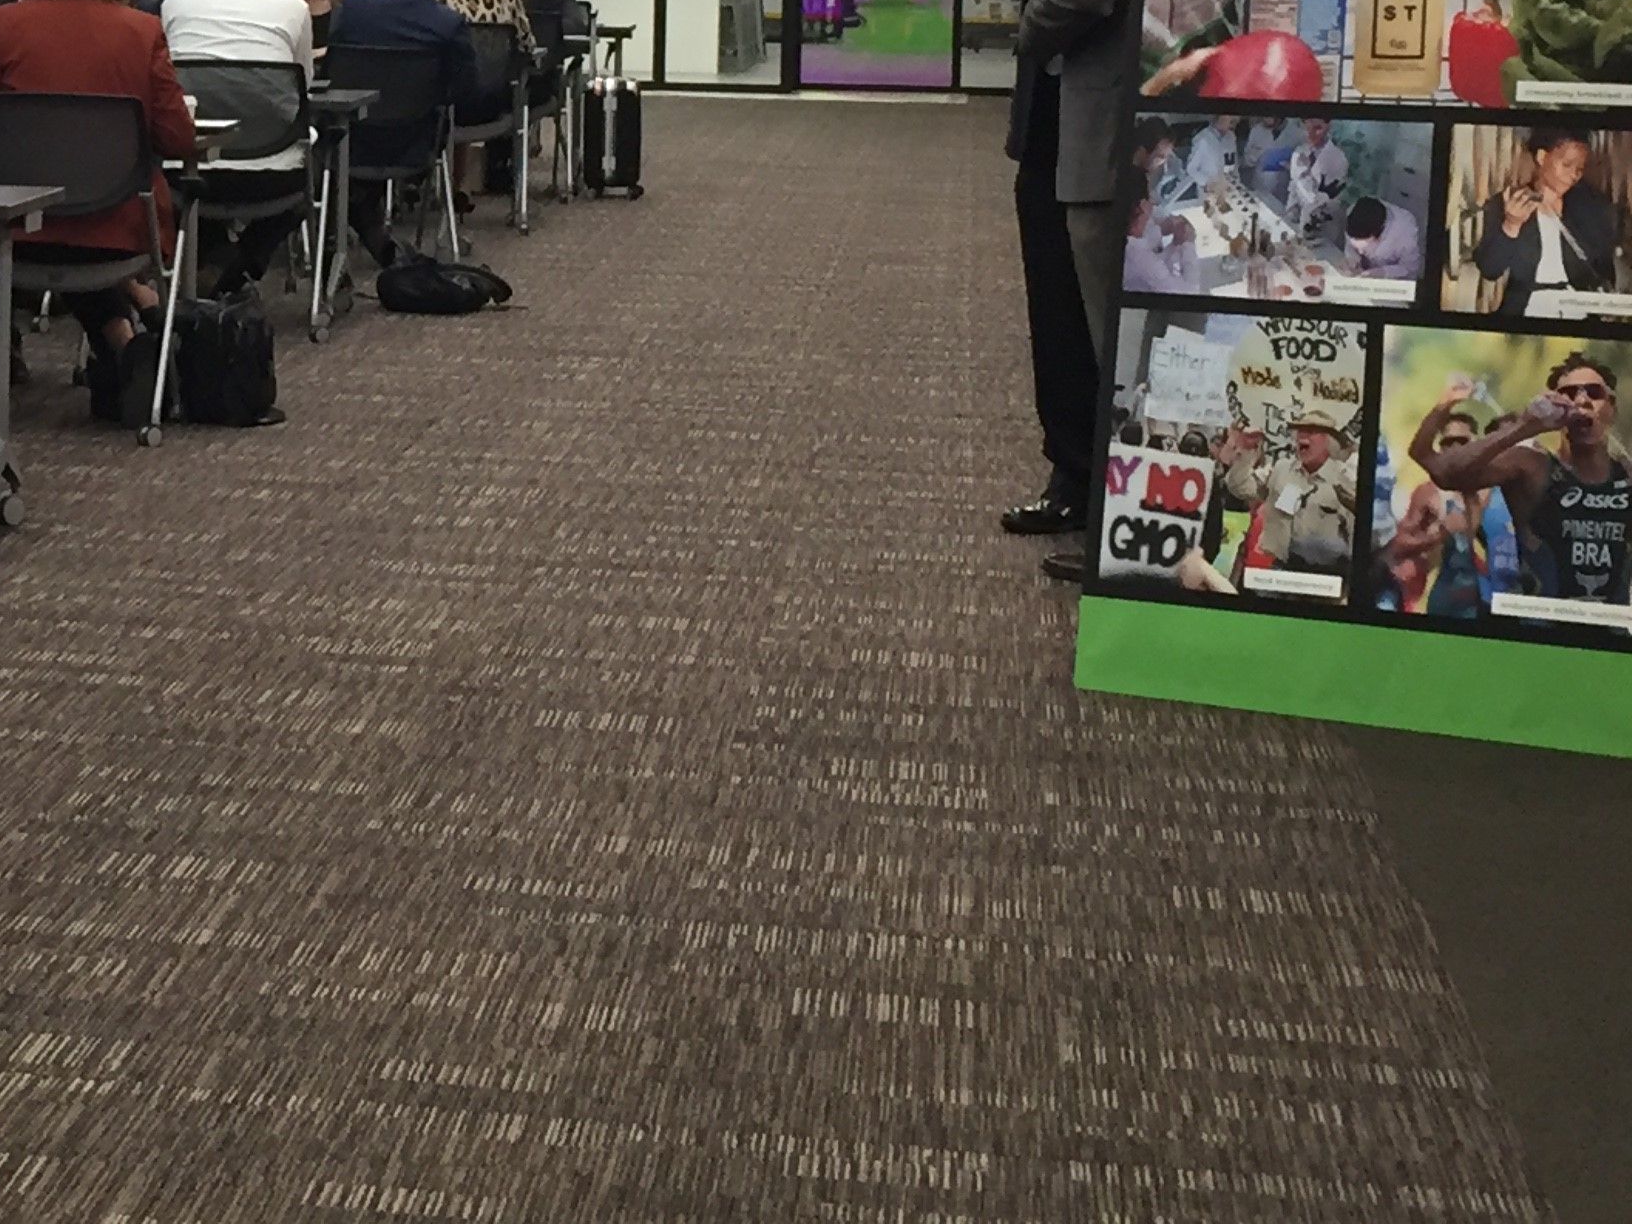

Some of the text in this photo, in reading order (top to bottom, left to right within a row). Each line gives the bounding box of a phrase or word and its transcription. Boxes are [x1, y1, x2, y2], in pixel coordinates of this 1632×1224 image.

[1270, 336, 1337, 362] FOOD
[1146, 462, 1206, 513] NO
[1562, 519, 1626, 541] PIMENTEL
[1571, 541, 1612, 568] BRA
